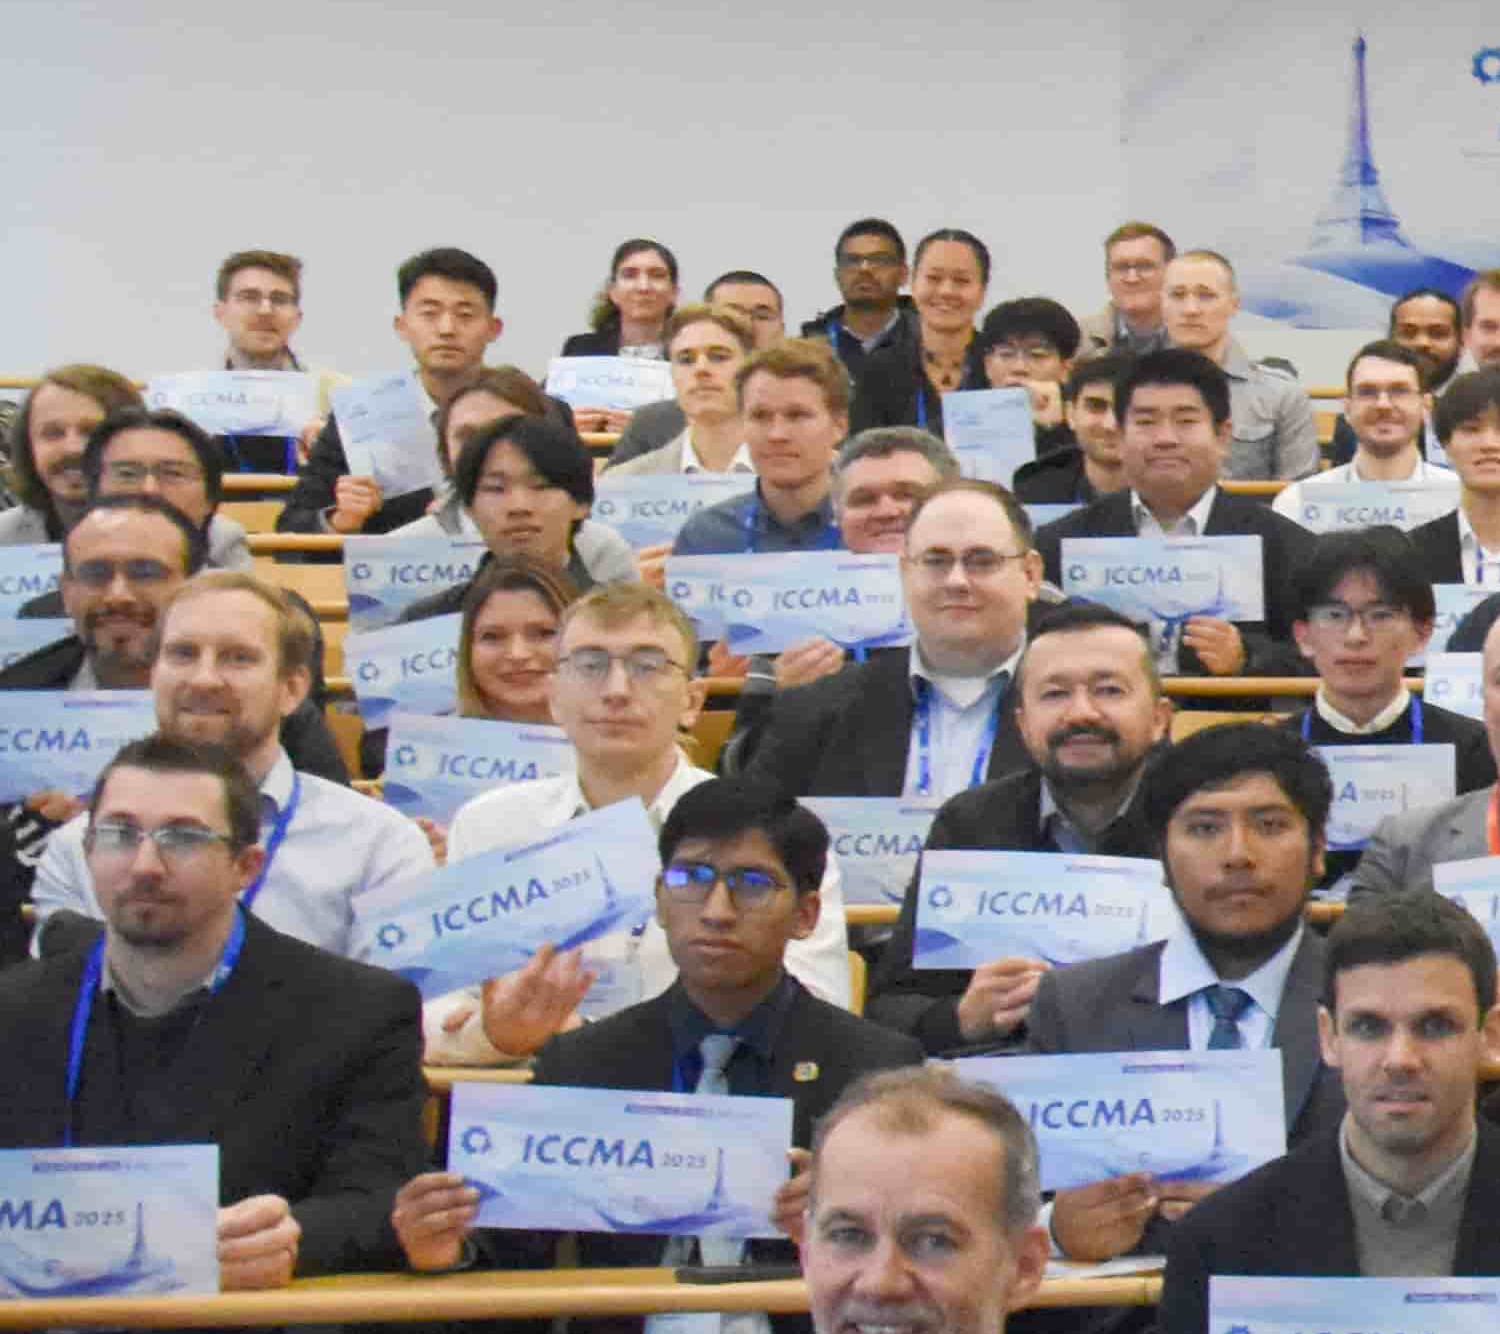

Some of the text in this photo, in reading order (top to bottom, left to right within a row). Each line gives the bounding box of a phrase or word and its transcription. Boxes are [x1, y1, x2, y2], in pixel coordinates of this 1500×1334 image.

[1337, 507, 1407, 524] ICCMA
[0, 574, 60, 595] CMA
[390, 562, 472, 584] ICCMA
[1104, 565, 1182, 584] ICCMA
[773, 587, 861, 611] ICCMA
[401, 648, 457, 676] ICC
[437, 753, 538, 784] ICCMA
[831, 833, 923, 856] CCMA
[432, 877, 549, 938] ICCMA
[977, 890, 1089, 917] ICCMA
[1030, 1098, 1157, 1131] ICCMA
[522, 1134, 655, 1169] ICCMA
